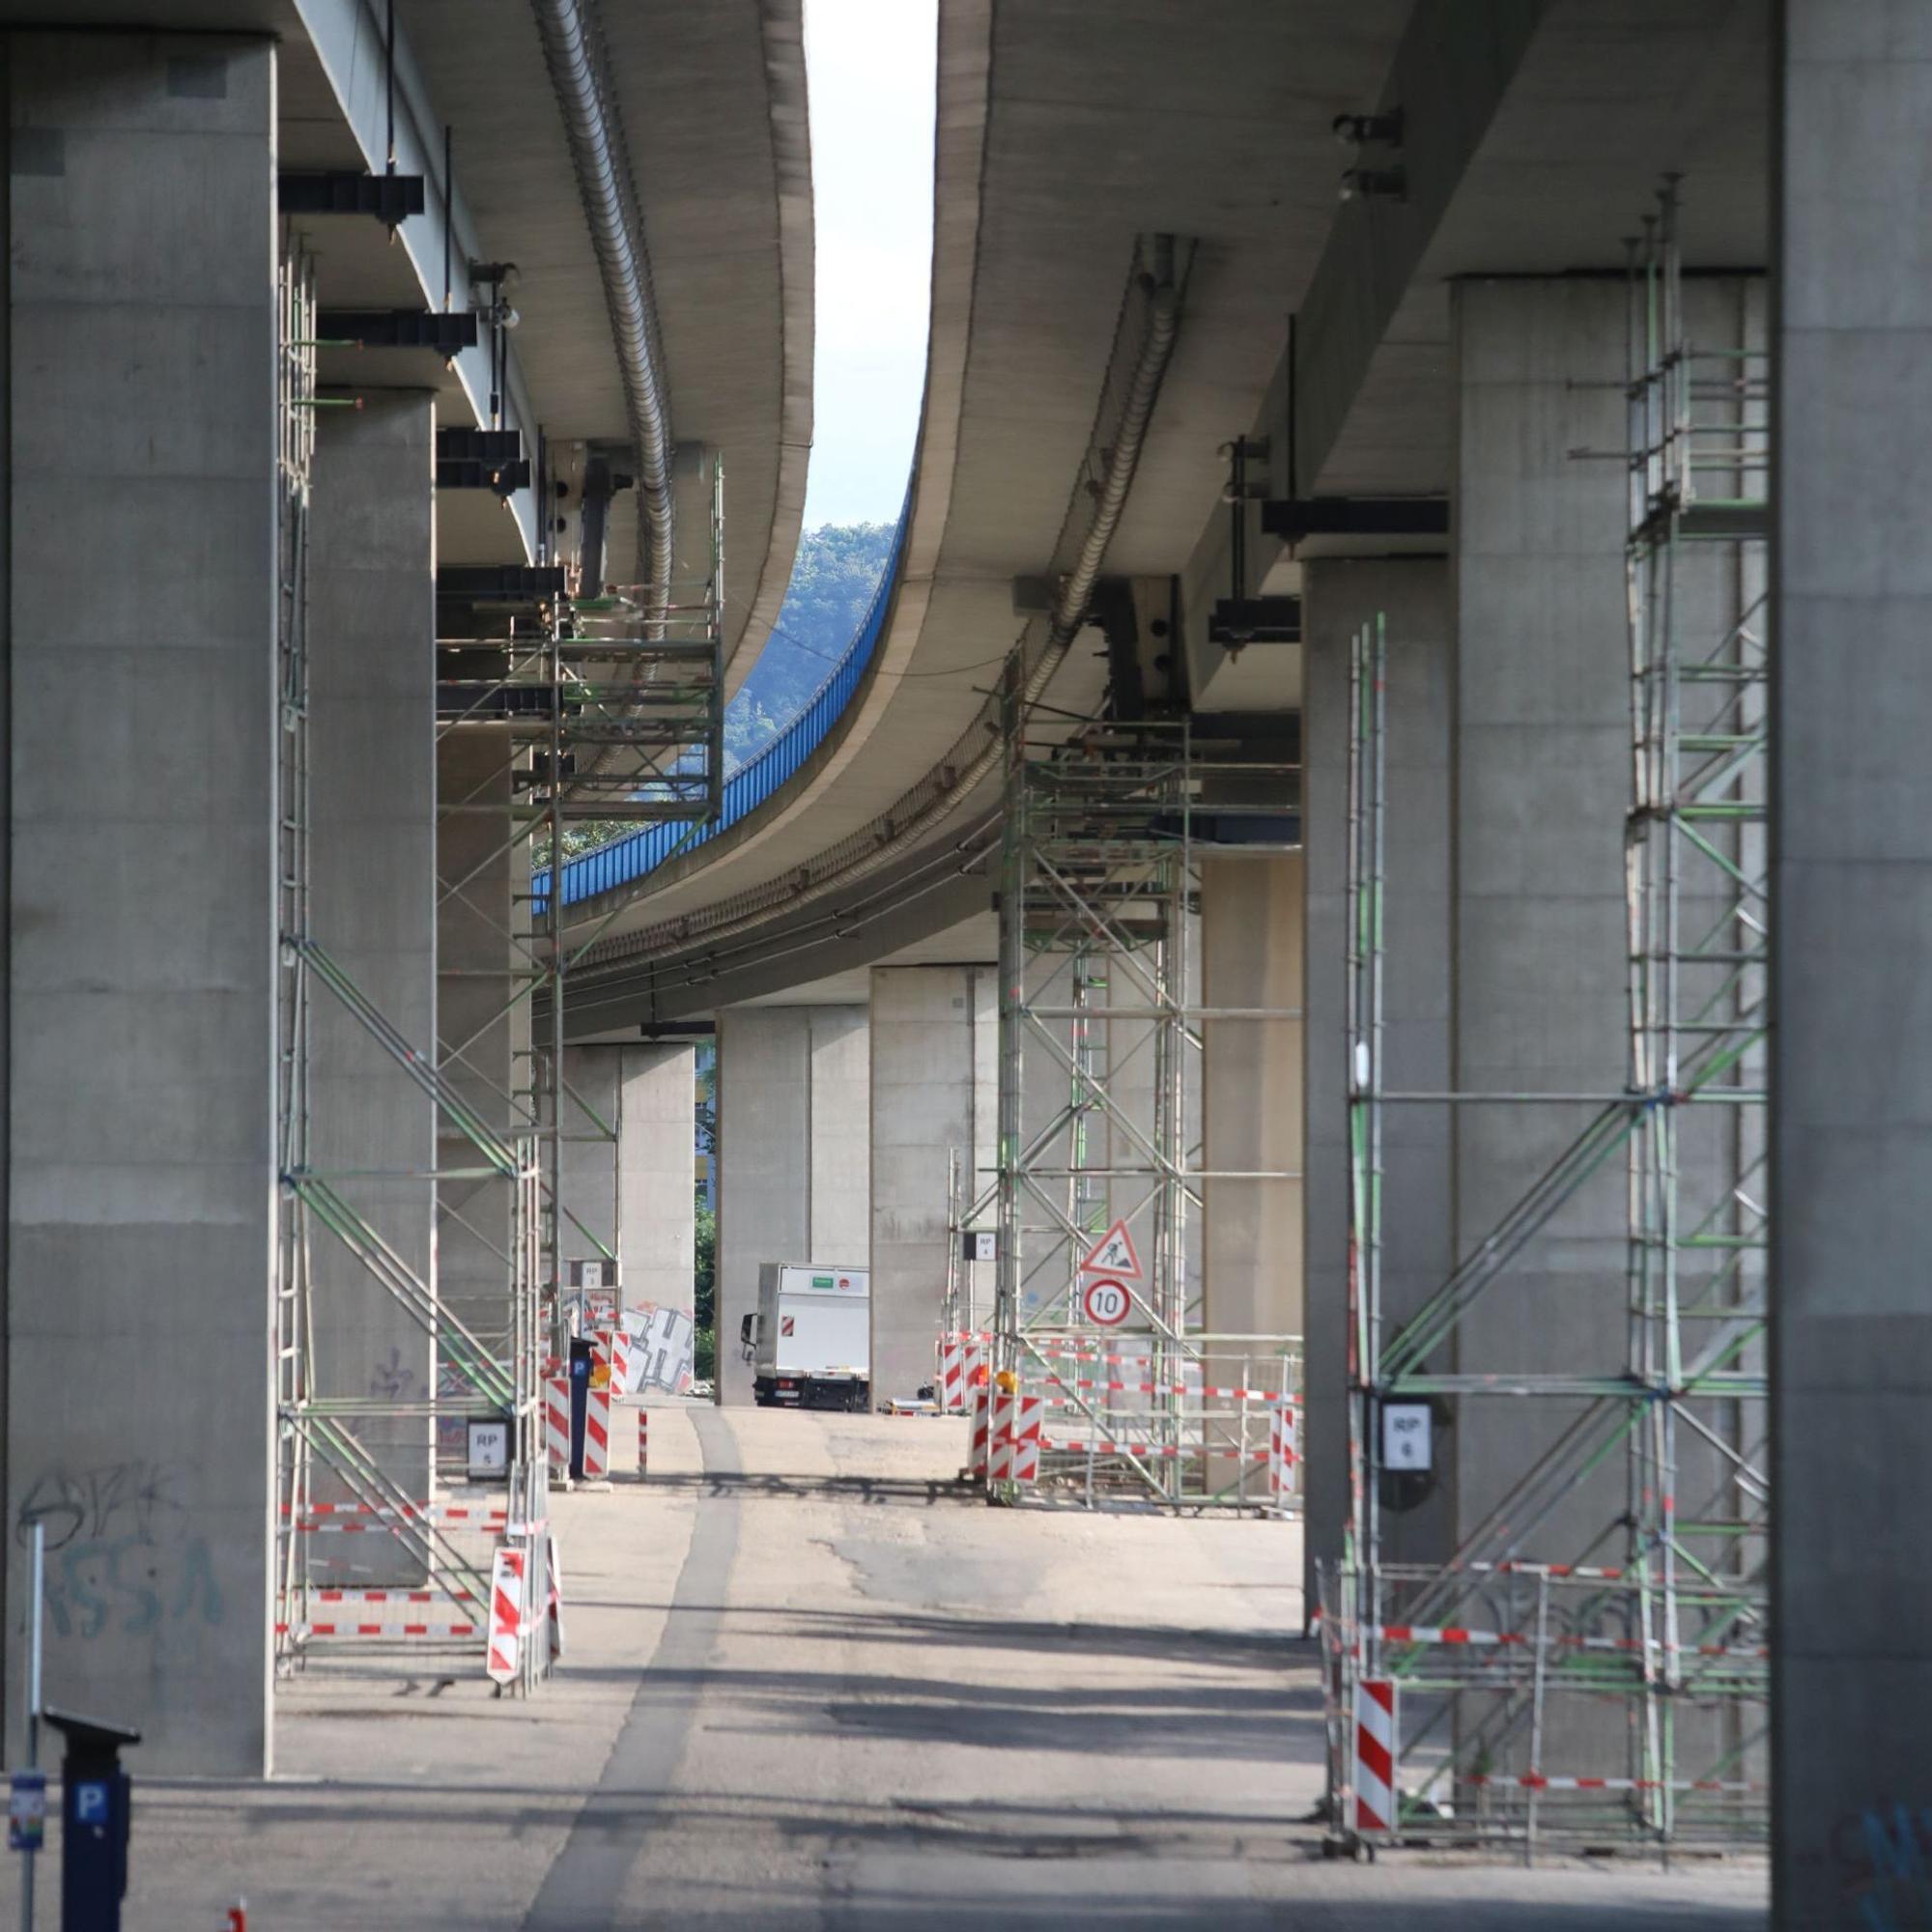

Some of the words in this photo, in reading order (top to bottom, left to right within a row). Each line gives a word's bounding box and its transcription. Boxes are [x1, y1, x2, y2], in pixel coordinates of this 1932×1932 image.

[1095, 1293, 1118, 1314] 10
[575, 1362, 584, 1375] P
[476, 1434, 497, 1446] RP
[78, 1784, 104, 1819] P
